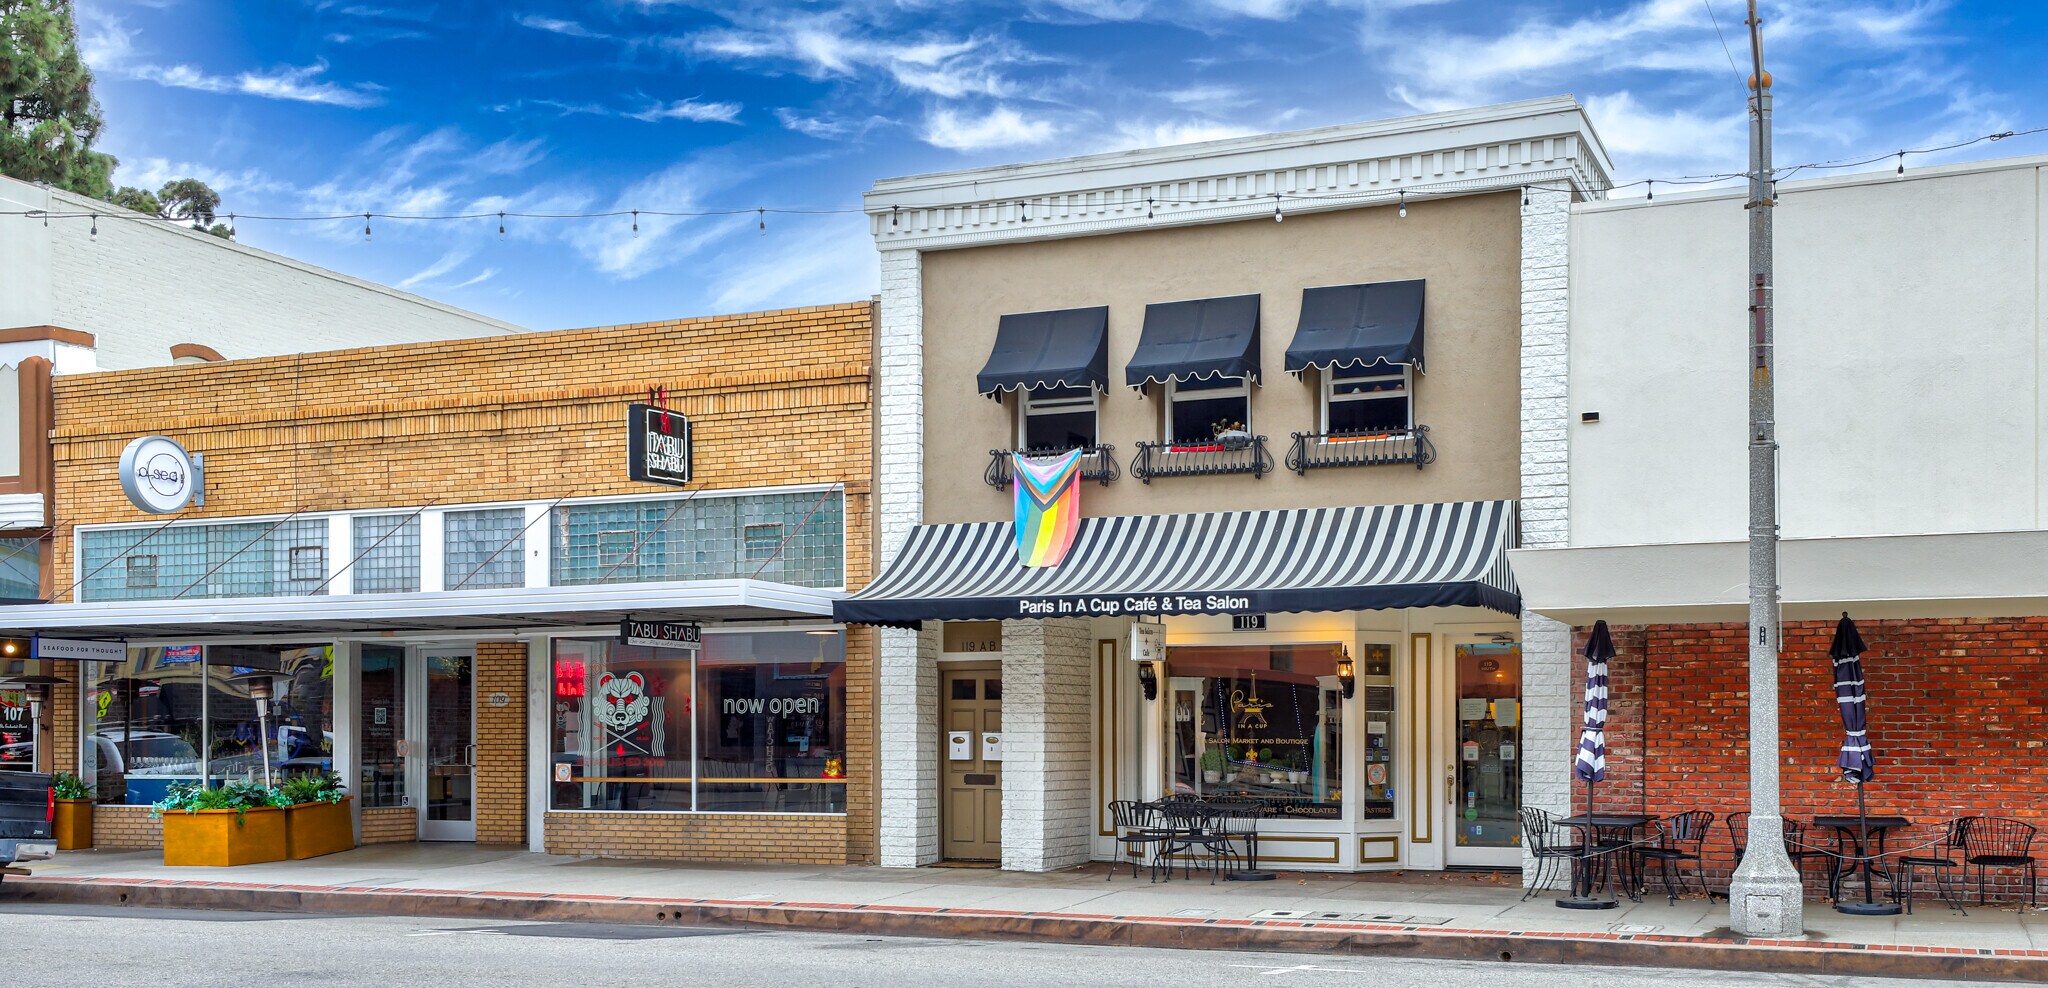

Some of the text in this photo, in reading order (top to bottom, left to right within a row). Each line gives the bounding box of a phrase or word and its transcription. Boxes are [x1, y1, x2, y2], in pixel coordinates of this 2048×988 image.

[1020, 595, 1249, 615] Paris In A Cup Café & Tea Salon
[1240, 615, 1258, 628] 119
[629, 622, 701, 642] TABU SHABU
[962, 641, 996, 652] 119 A B
[723, 697, 819, 719] now open
[1230, 690, 1274, 713] Paris
[4, 707, 24, 721] 107
[1285, 805, 1337, 814] CHOCOLATES
